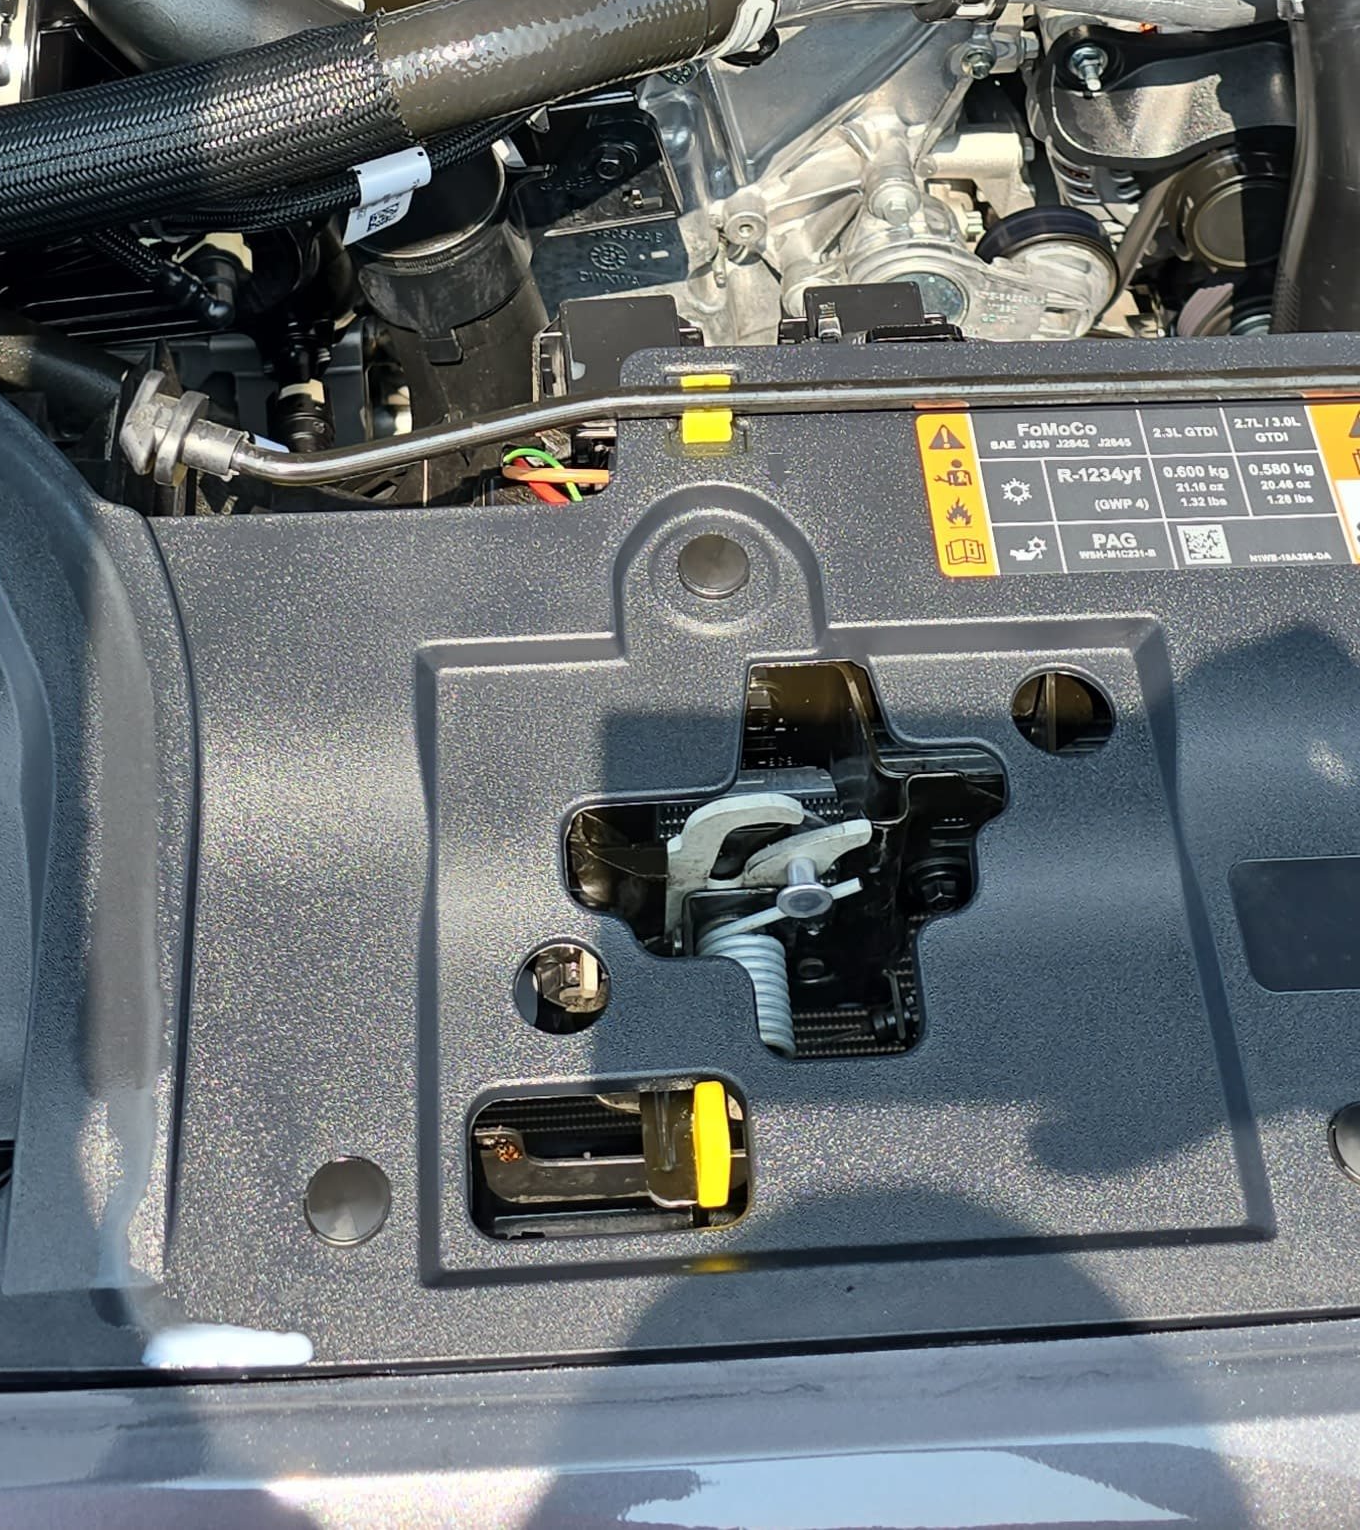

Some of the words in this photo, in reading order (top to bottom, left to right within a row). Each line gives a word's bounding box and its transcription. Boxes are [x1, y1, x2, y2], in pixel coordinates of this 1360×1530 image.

[1234, 418, 1263, 429] 2.7L
[1274, 416, 1301, 427] 3.0L
[1017, 422, 1097, 437] FoMoCo
[1153, 427, 1182, 438] 2.3L
[1184, 427, 1218, 437] GTDI
[1255, 432, 1289, 443] GTDI
[990, 441, 1016, 450] SAE
[1022, 440, 1050, 449] J639
[1057, 466, 1142, 485] R-1234yf
[1162, 466, 1205, 478] 0.600
[1208, 465, 1230, 479] kg
[1248, 463, 1291, 476] 0.580
[1293, 463, 1315, 476] kg
[1175, 482, 1207, 492] 21.16
[1209, 483, 1225, 492] oz
[1260, 480, 1294, 491] 20.46
[1295, 481, 1312, 489] oz
[1094, 498, 1132, 512] (GWP
[1135, 498, 1150, 511] 4)
[1180, 497, 1206, 507] 1.32
[1208, 496, 1228, 506] lbs
[1266, 495, 1292, 505] 1.28
[1293, 494, 1314, 504] lbs
[1092, 532, 1137, 549] PAG
